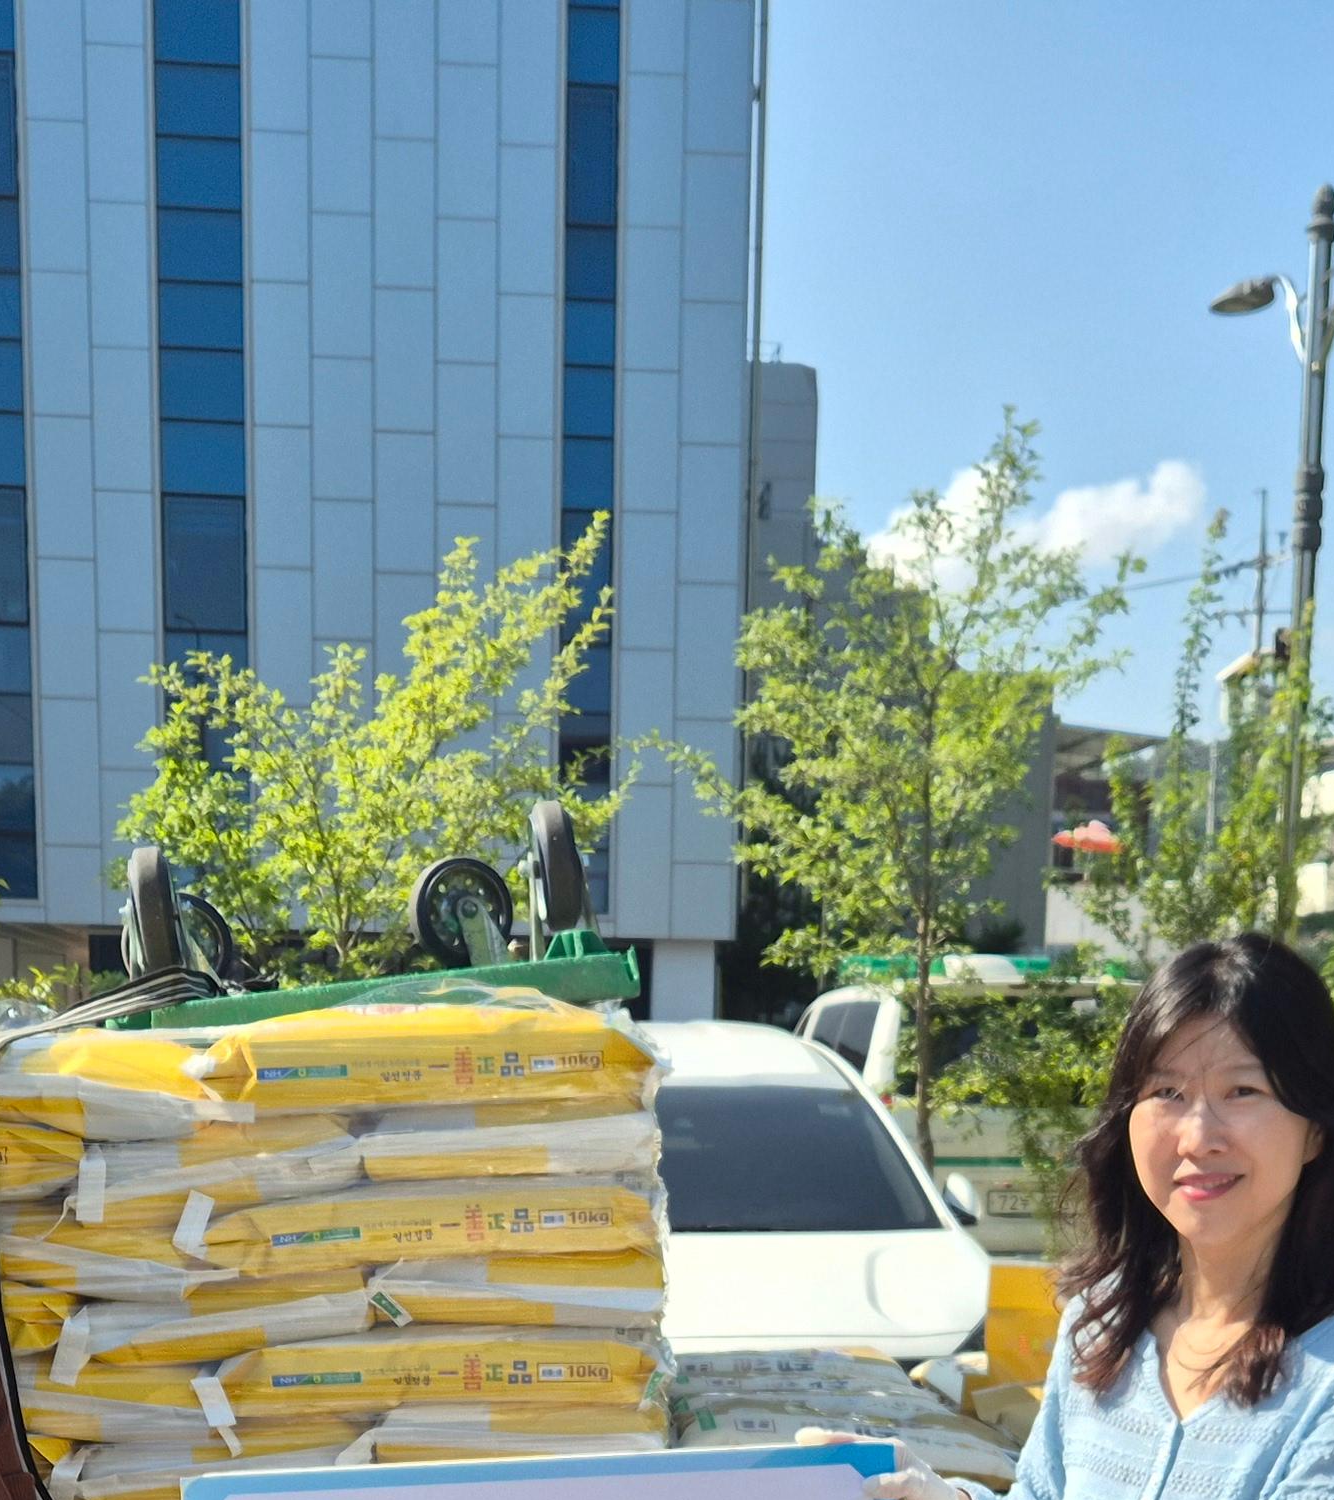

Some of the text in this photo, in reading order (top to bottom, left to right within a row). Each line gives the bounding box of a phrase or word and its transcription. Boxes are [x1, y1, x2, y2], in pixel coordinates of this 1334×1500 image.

[560, 1053, 601, 1069] 10kg
[569, 1211, 610, 1226] 10kg
[567, 1363, 609, 1379] 10kg
